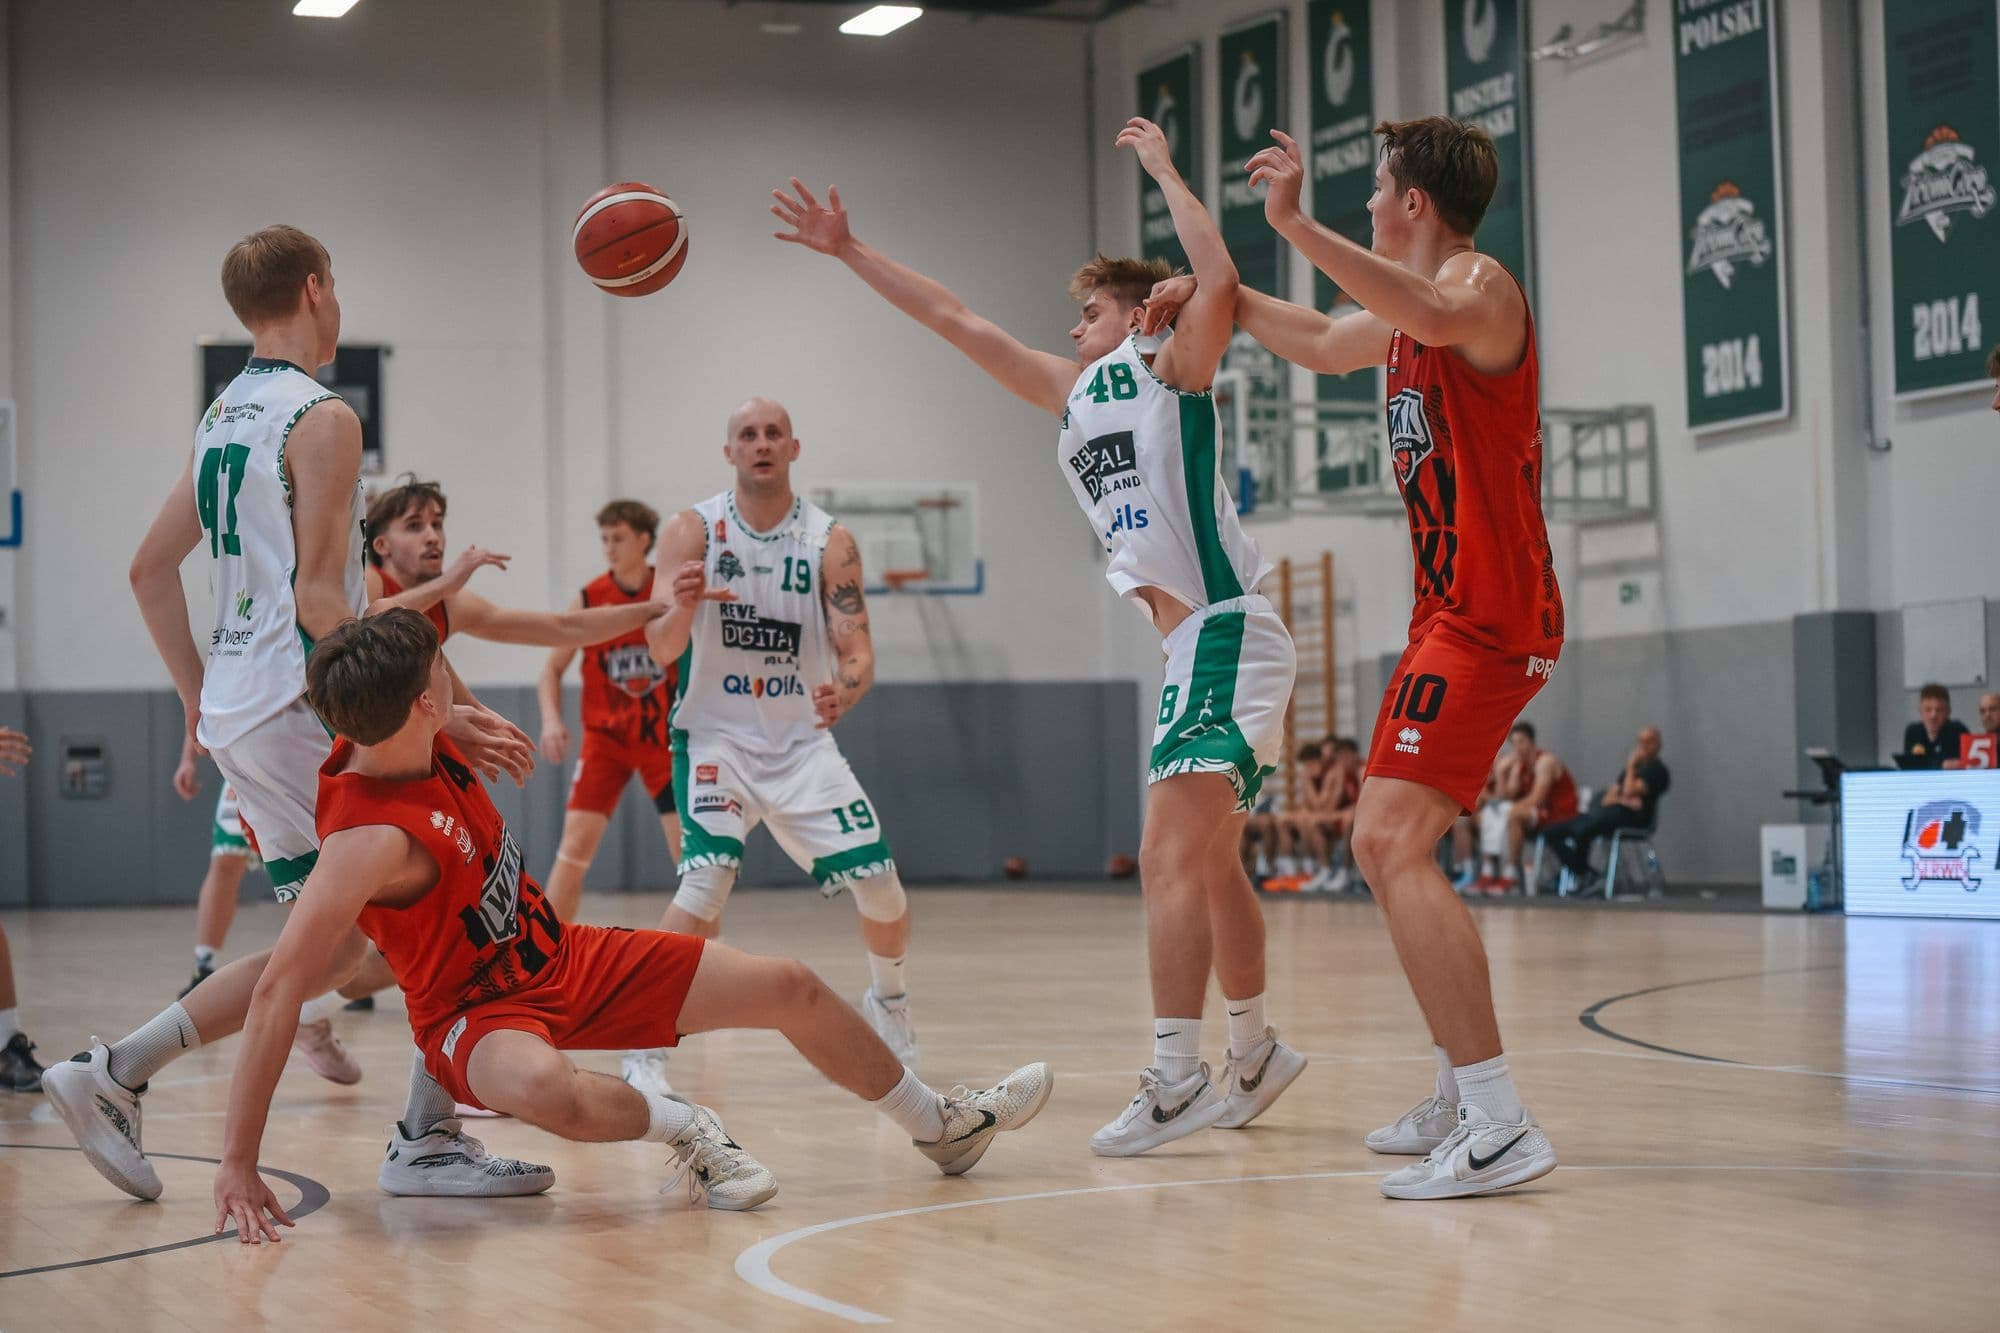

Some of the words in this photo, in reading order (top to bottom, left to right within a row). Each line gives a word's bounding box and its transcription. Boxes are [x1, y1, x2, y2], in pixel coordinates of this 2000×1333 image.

[1680, 0, 1761, 56] POLSKI
[1912, 293, 1982, 361] 2014
[1086, 363, 1138, 403] 48
[1703, 334, 1763, 397] 2014
[197, 442, 251, 559] 47
[780, 556, 811, 594] 19
[1392, 672, 1448, 724] 10
[1966, 738, 1991, 769] 5
[832, 799, 875, 834] 19
